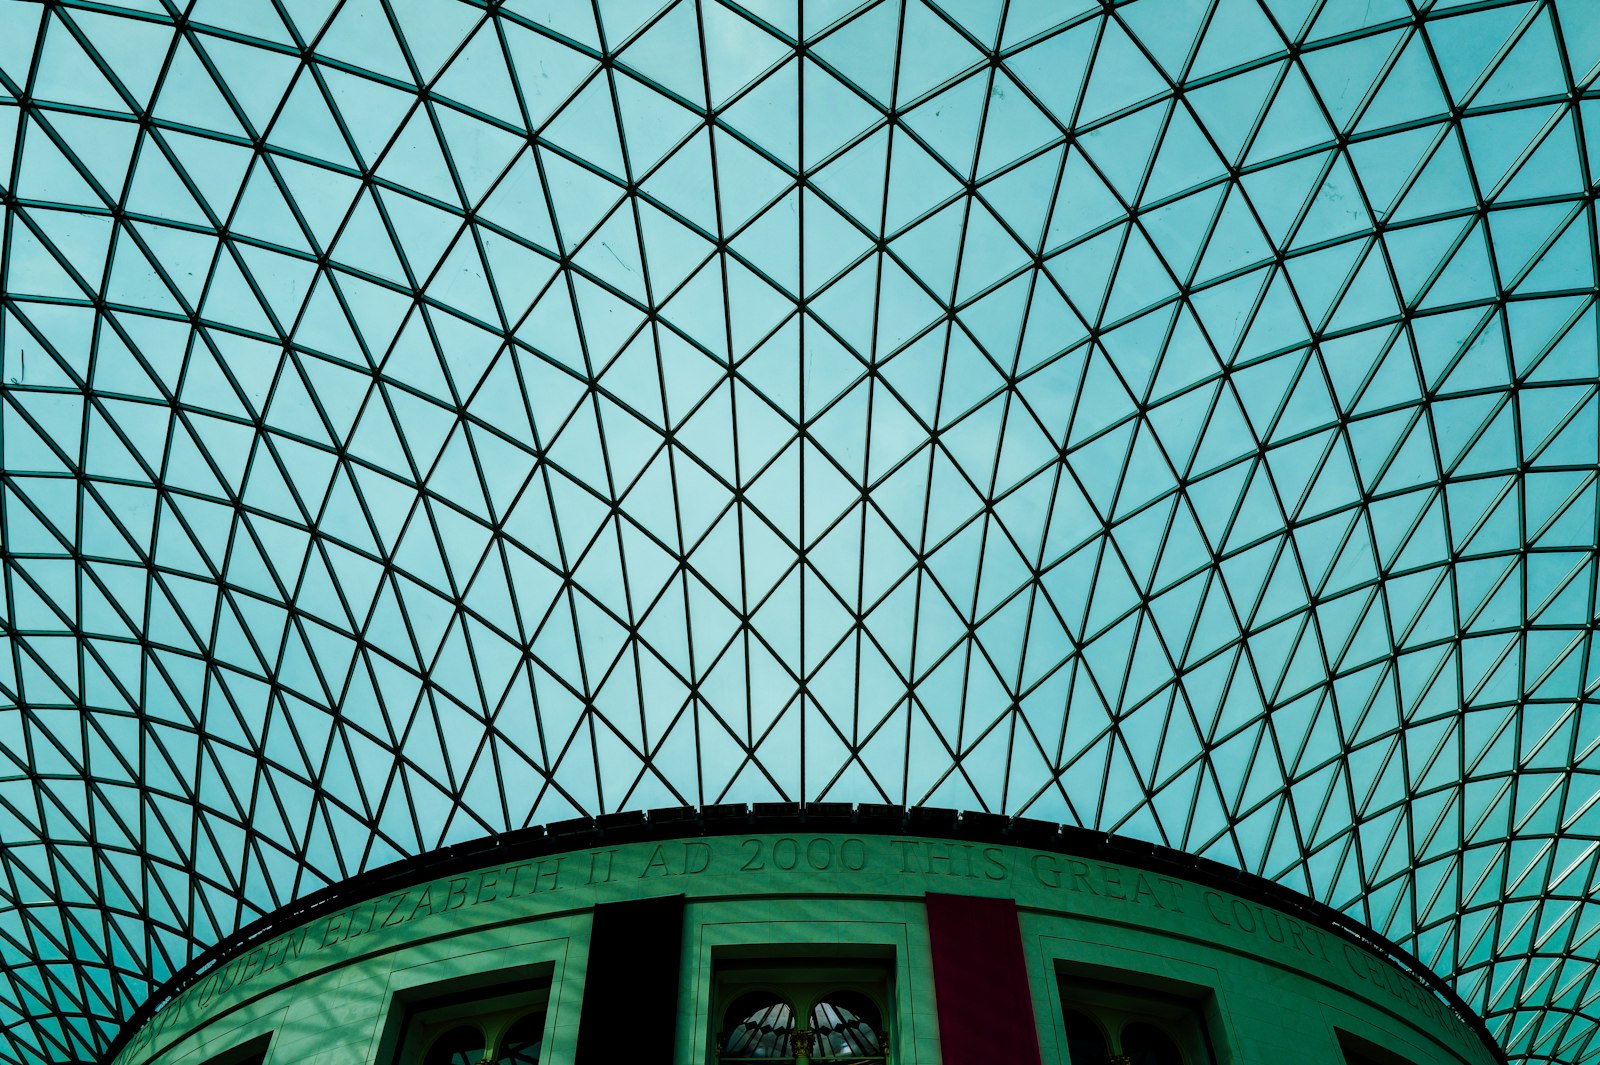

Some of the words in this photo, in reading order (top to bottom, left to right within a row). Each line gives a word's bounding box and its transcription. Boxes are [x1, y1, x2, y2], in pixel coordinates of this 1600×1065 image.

[197, 925, 310, 1009] QUEEN
[317, 856, 568, 950] ELIZABETH
[583, 849, 620, 885] II
[637, 842, 712, 879] AD
[740, 837, 866, 871] 2000
[890, 839, 1008, 881] THIS
[1030, 854, 1185, 914] GREAT
[1203, 890, 1331, 963] COURT
